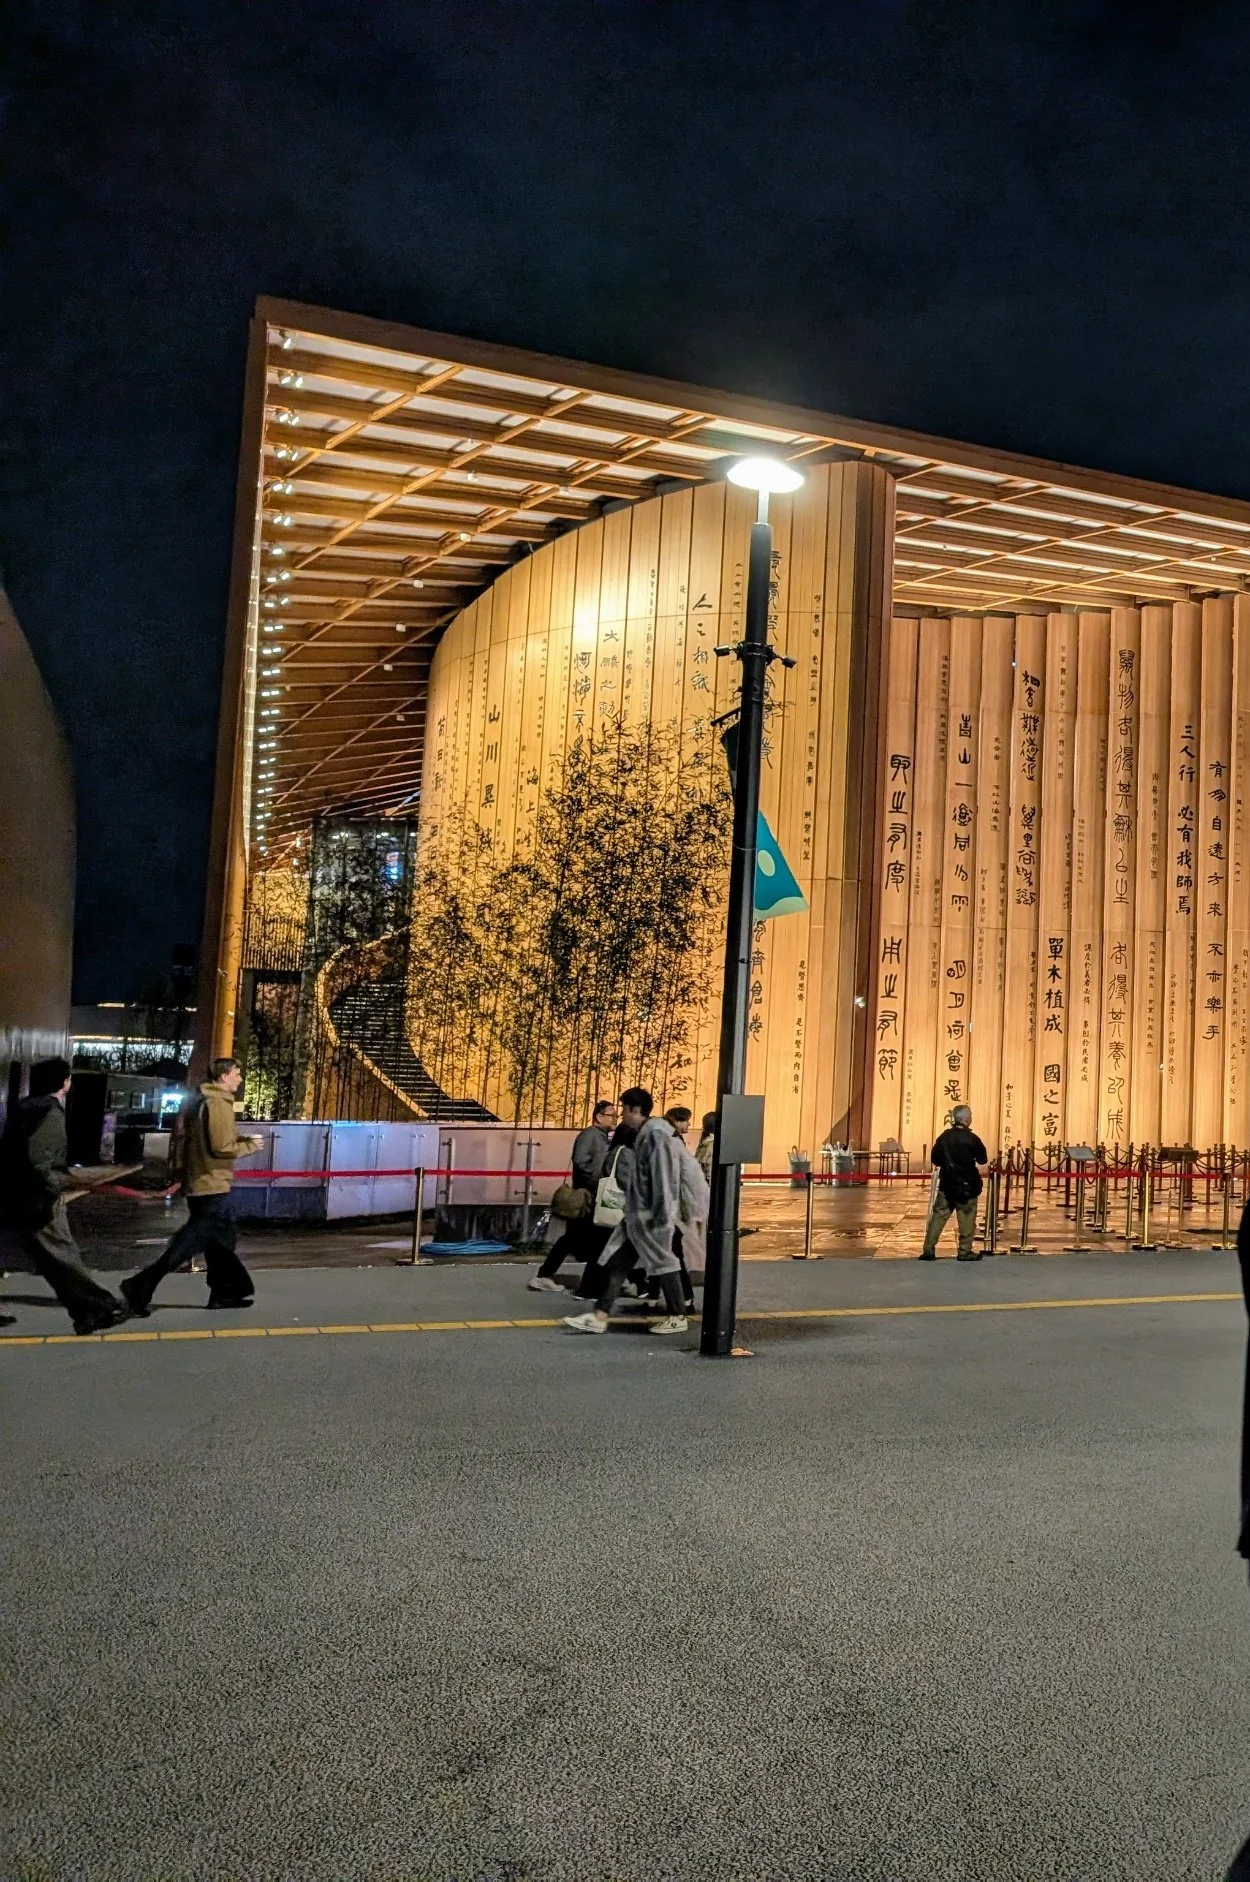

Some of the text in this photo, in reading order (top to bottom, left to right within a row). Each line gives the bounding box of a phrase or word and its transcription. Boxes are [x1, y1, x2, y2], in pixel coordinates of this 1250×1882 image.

[1178, 725, 1196, 783] 三人行
[1175, 805, 1194, 915] 必有我師焉
[1202, 943, 1224, 1040] 不亦樂乎
